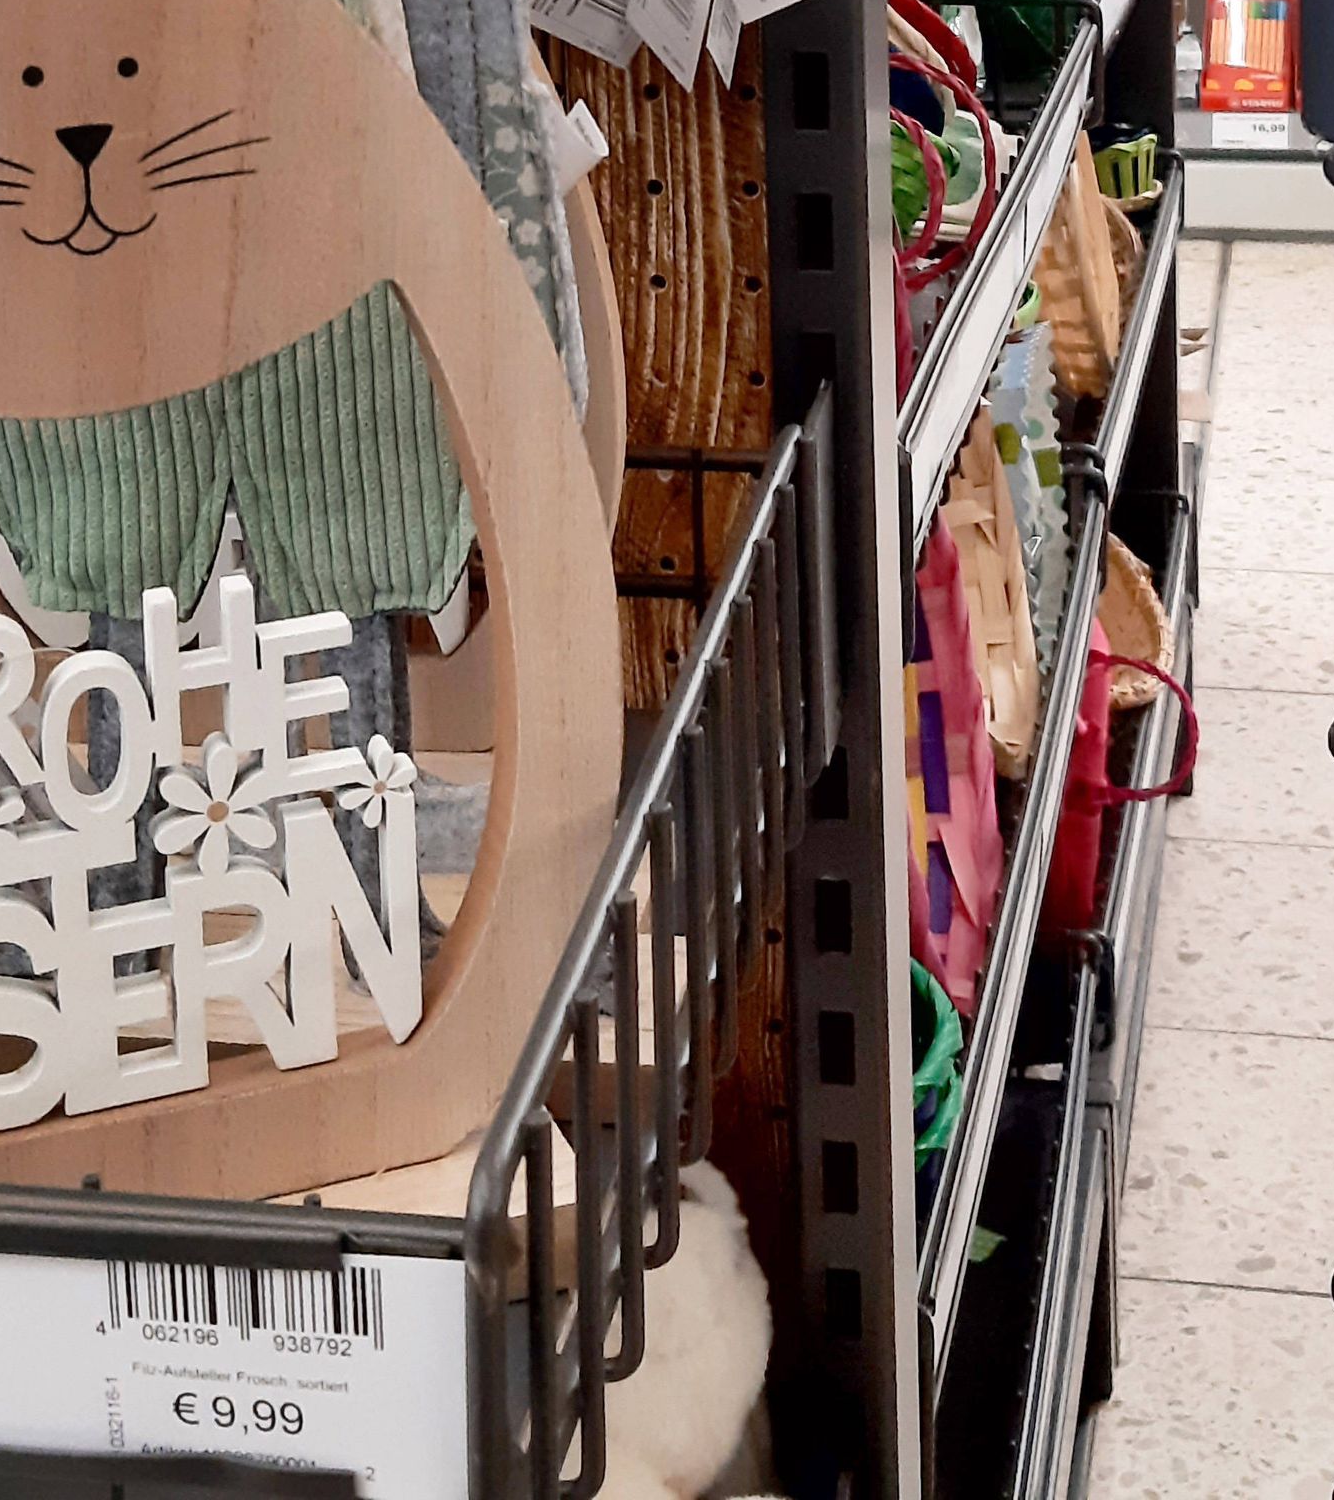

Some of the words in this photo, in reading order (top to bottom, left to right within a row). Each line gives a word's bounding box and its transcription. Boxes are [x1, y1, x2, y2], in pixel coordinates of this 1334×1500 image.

[96, 1322, 106, 1336] 4
[142, 1323, 219, 1346] 062196
[273, 1335, 352, 1357] 938792
[173, 1392, 200, 1425] €
[212, 1395, 304, 1435] 9,99
